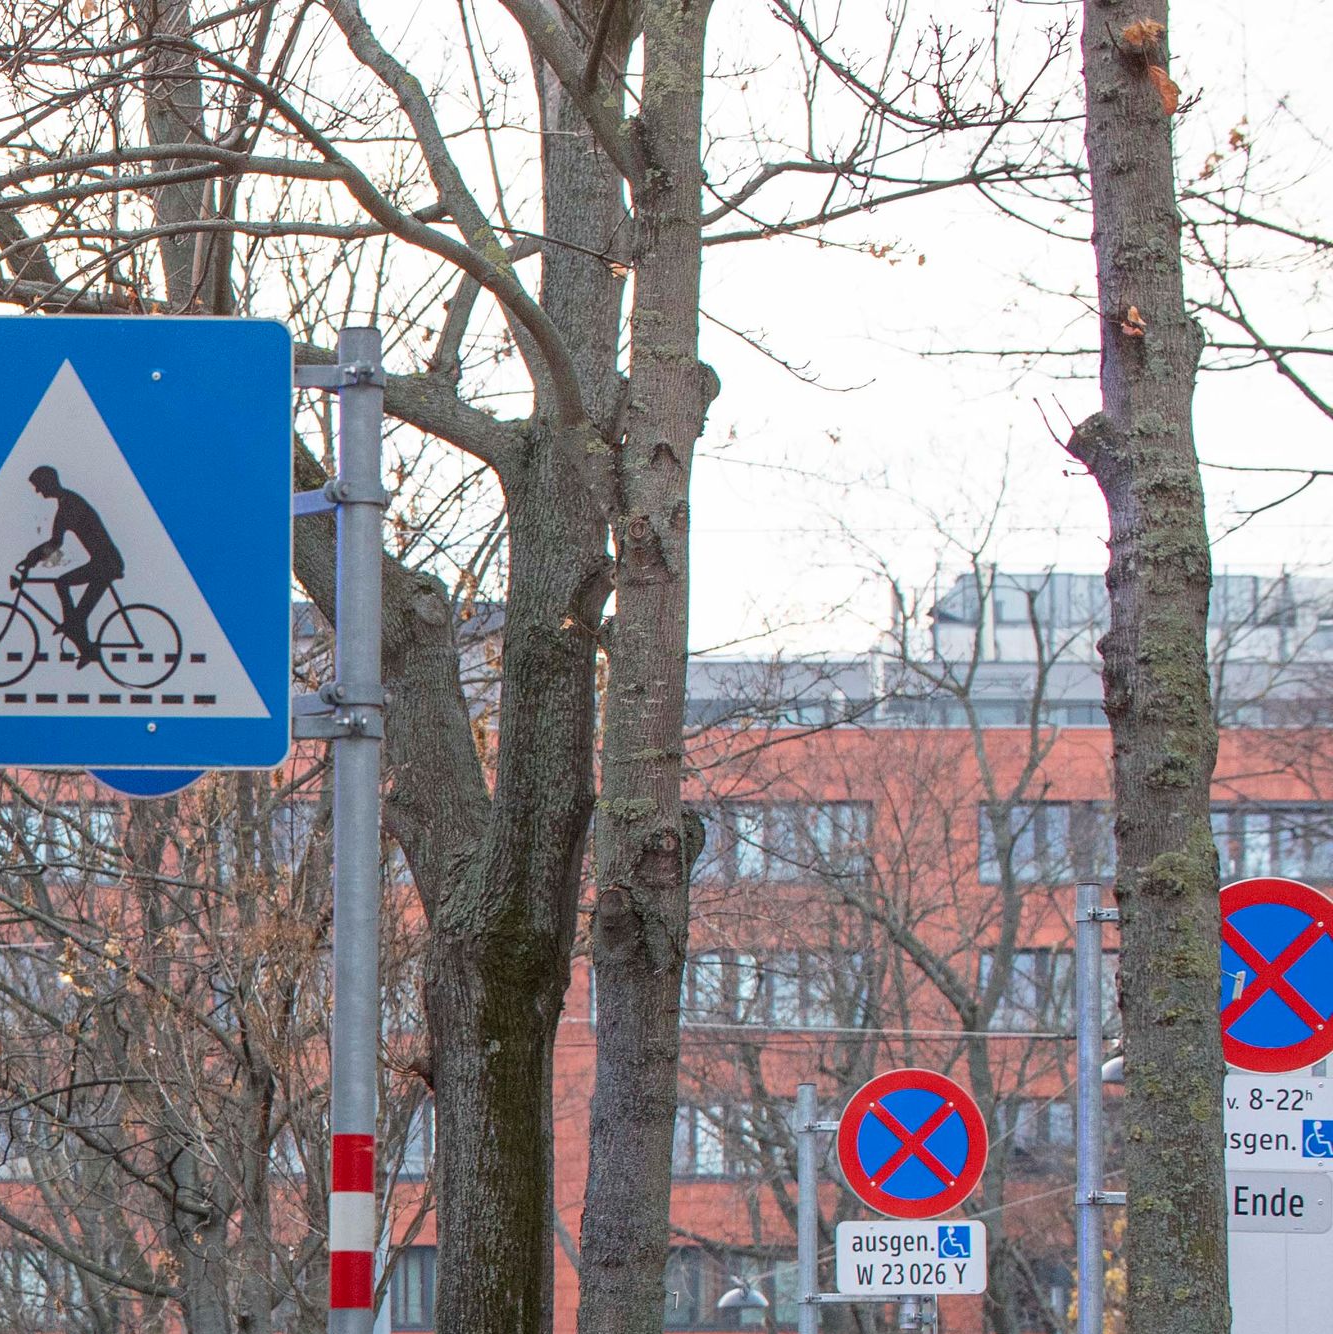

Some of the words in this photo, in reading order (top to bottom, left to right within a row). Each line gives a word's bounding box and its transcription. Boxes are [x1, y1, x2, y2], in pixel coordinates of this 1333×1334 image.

[1223, 1132, 1297, 1155] sgen.
[1234, 1186, 1304, 1218] Ende
[852, 1235, 935, 1257] ausgen.
[856, 1264, 874, 1285] W
[954, 1262, 967, 1284] Y
